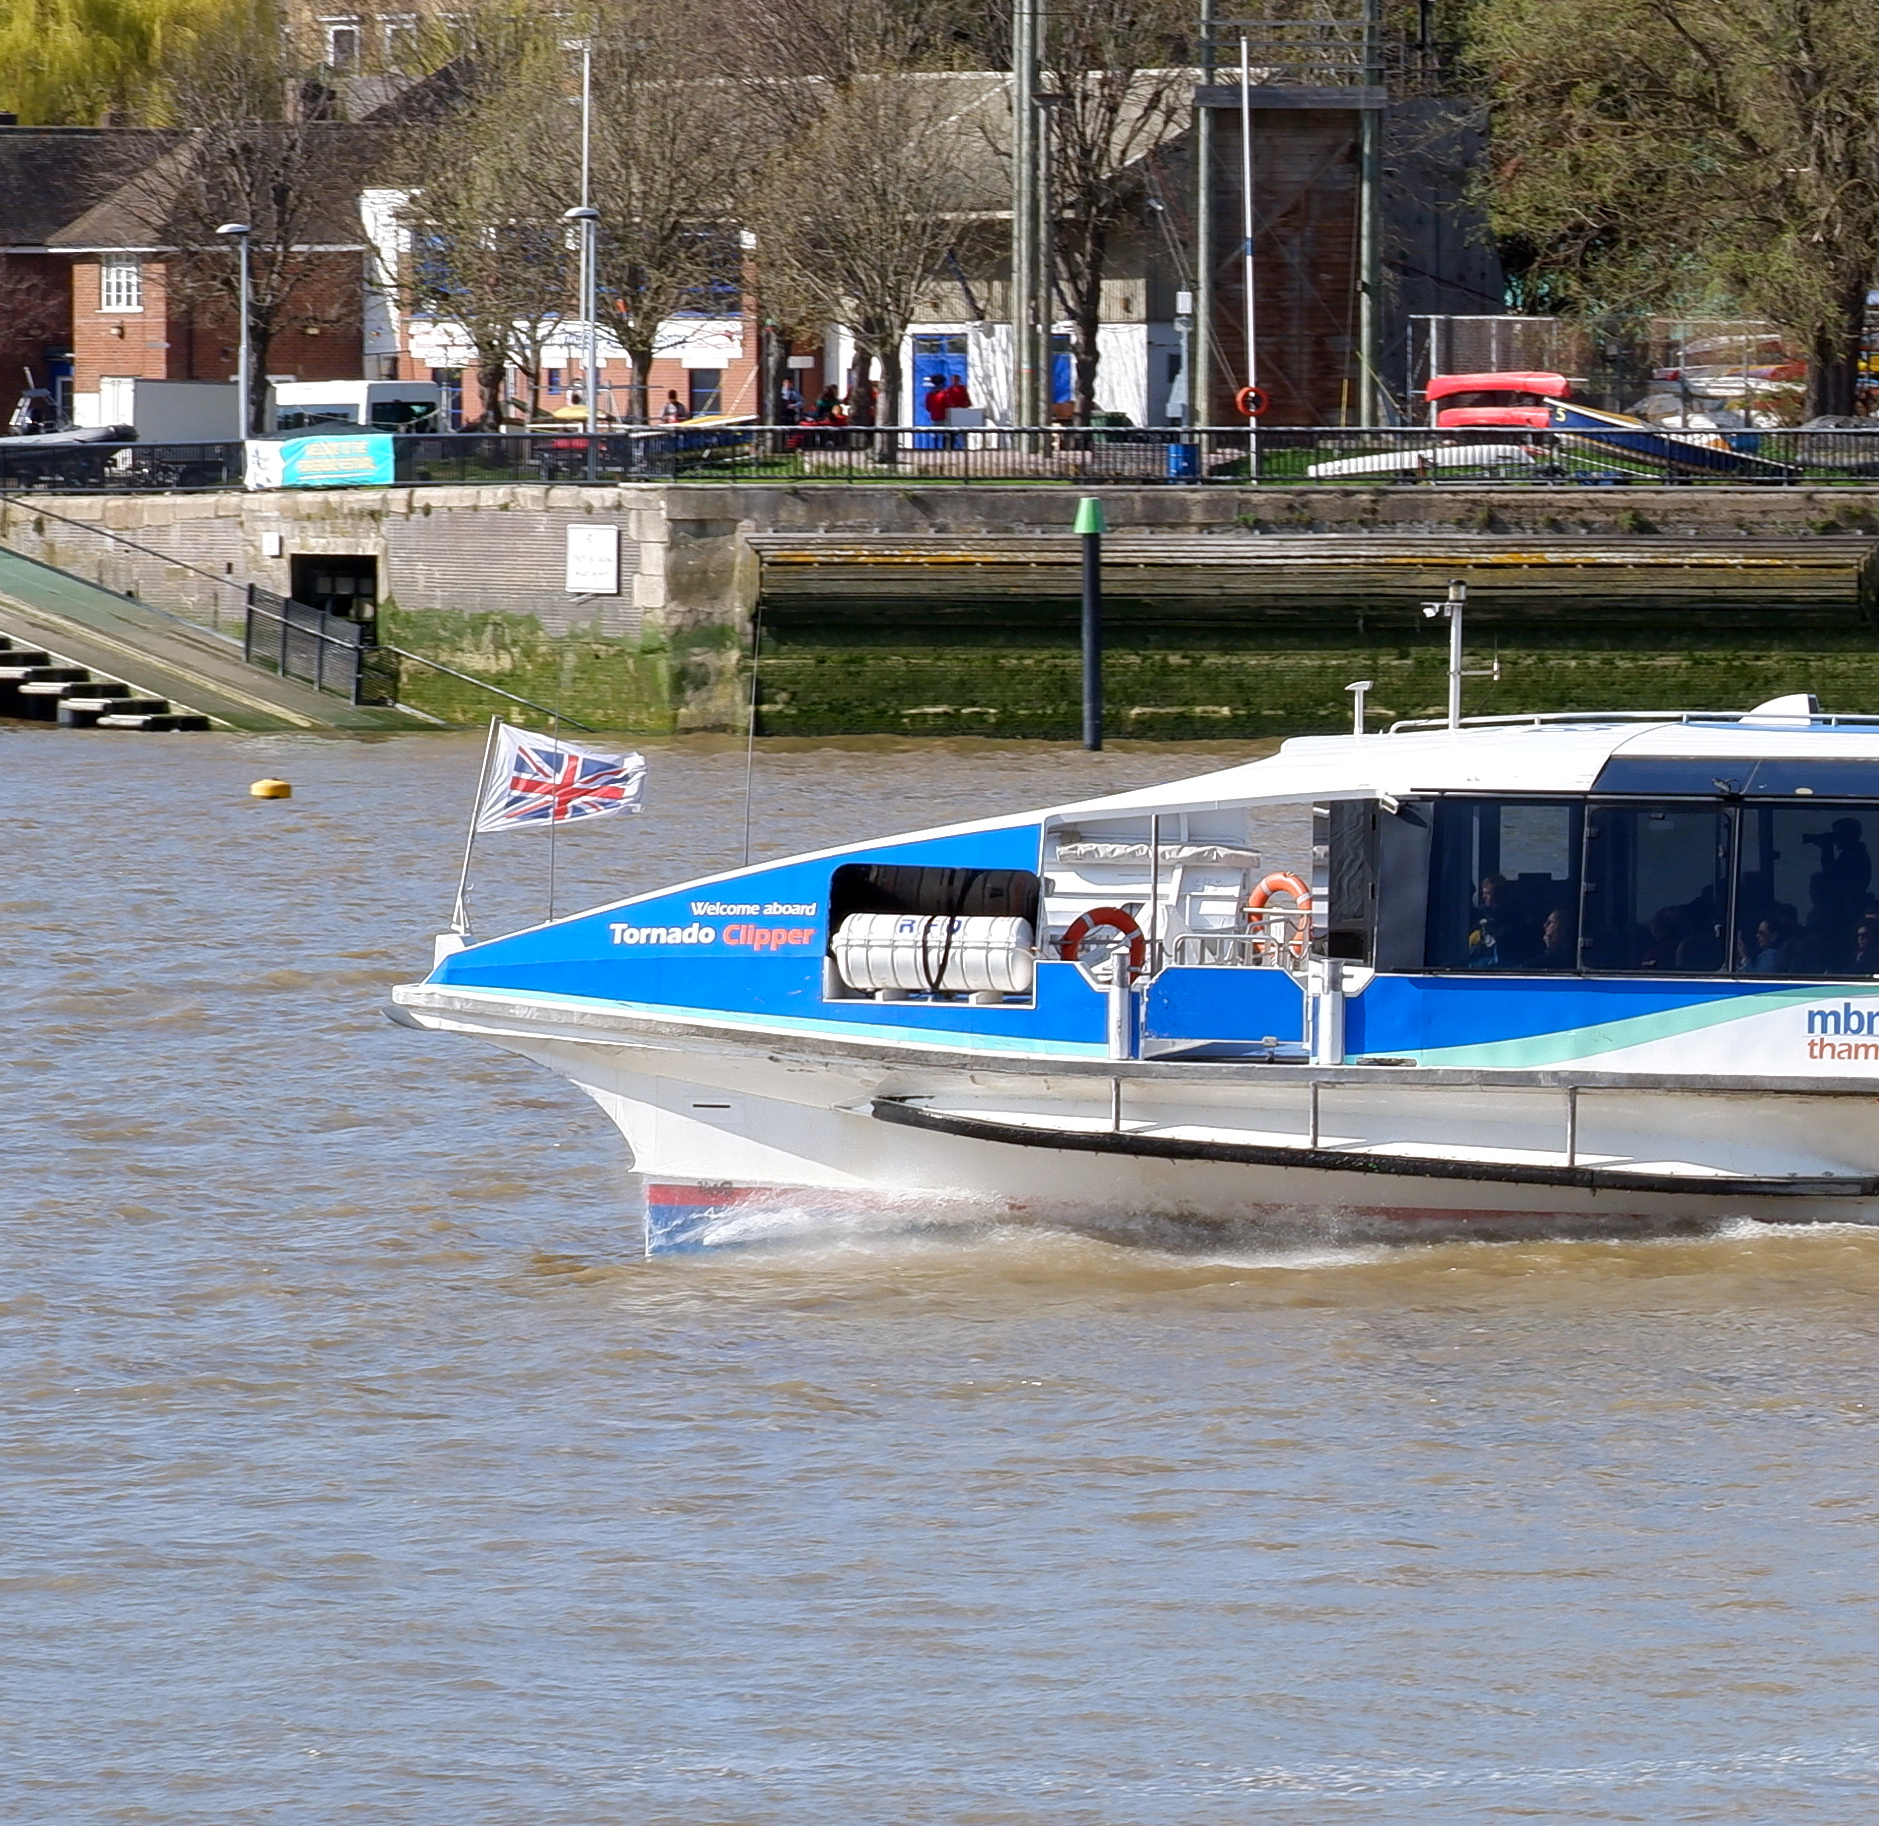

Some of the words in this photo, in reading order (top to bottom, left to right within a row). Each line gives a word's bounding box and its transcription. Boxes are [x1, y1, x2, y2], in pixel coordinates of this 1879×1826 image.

[690, 901, 759, 916] Welcome
[763, 902, 817, 916] aboard
[609, 922, 716, 945] Tornado
[723, 924, 815, 951] Clipper
